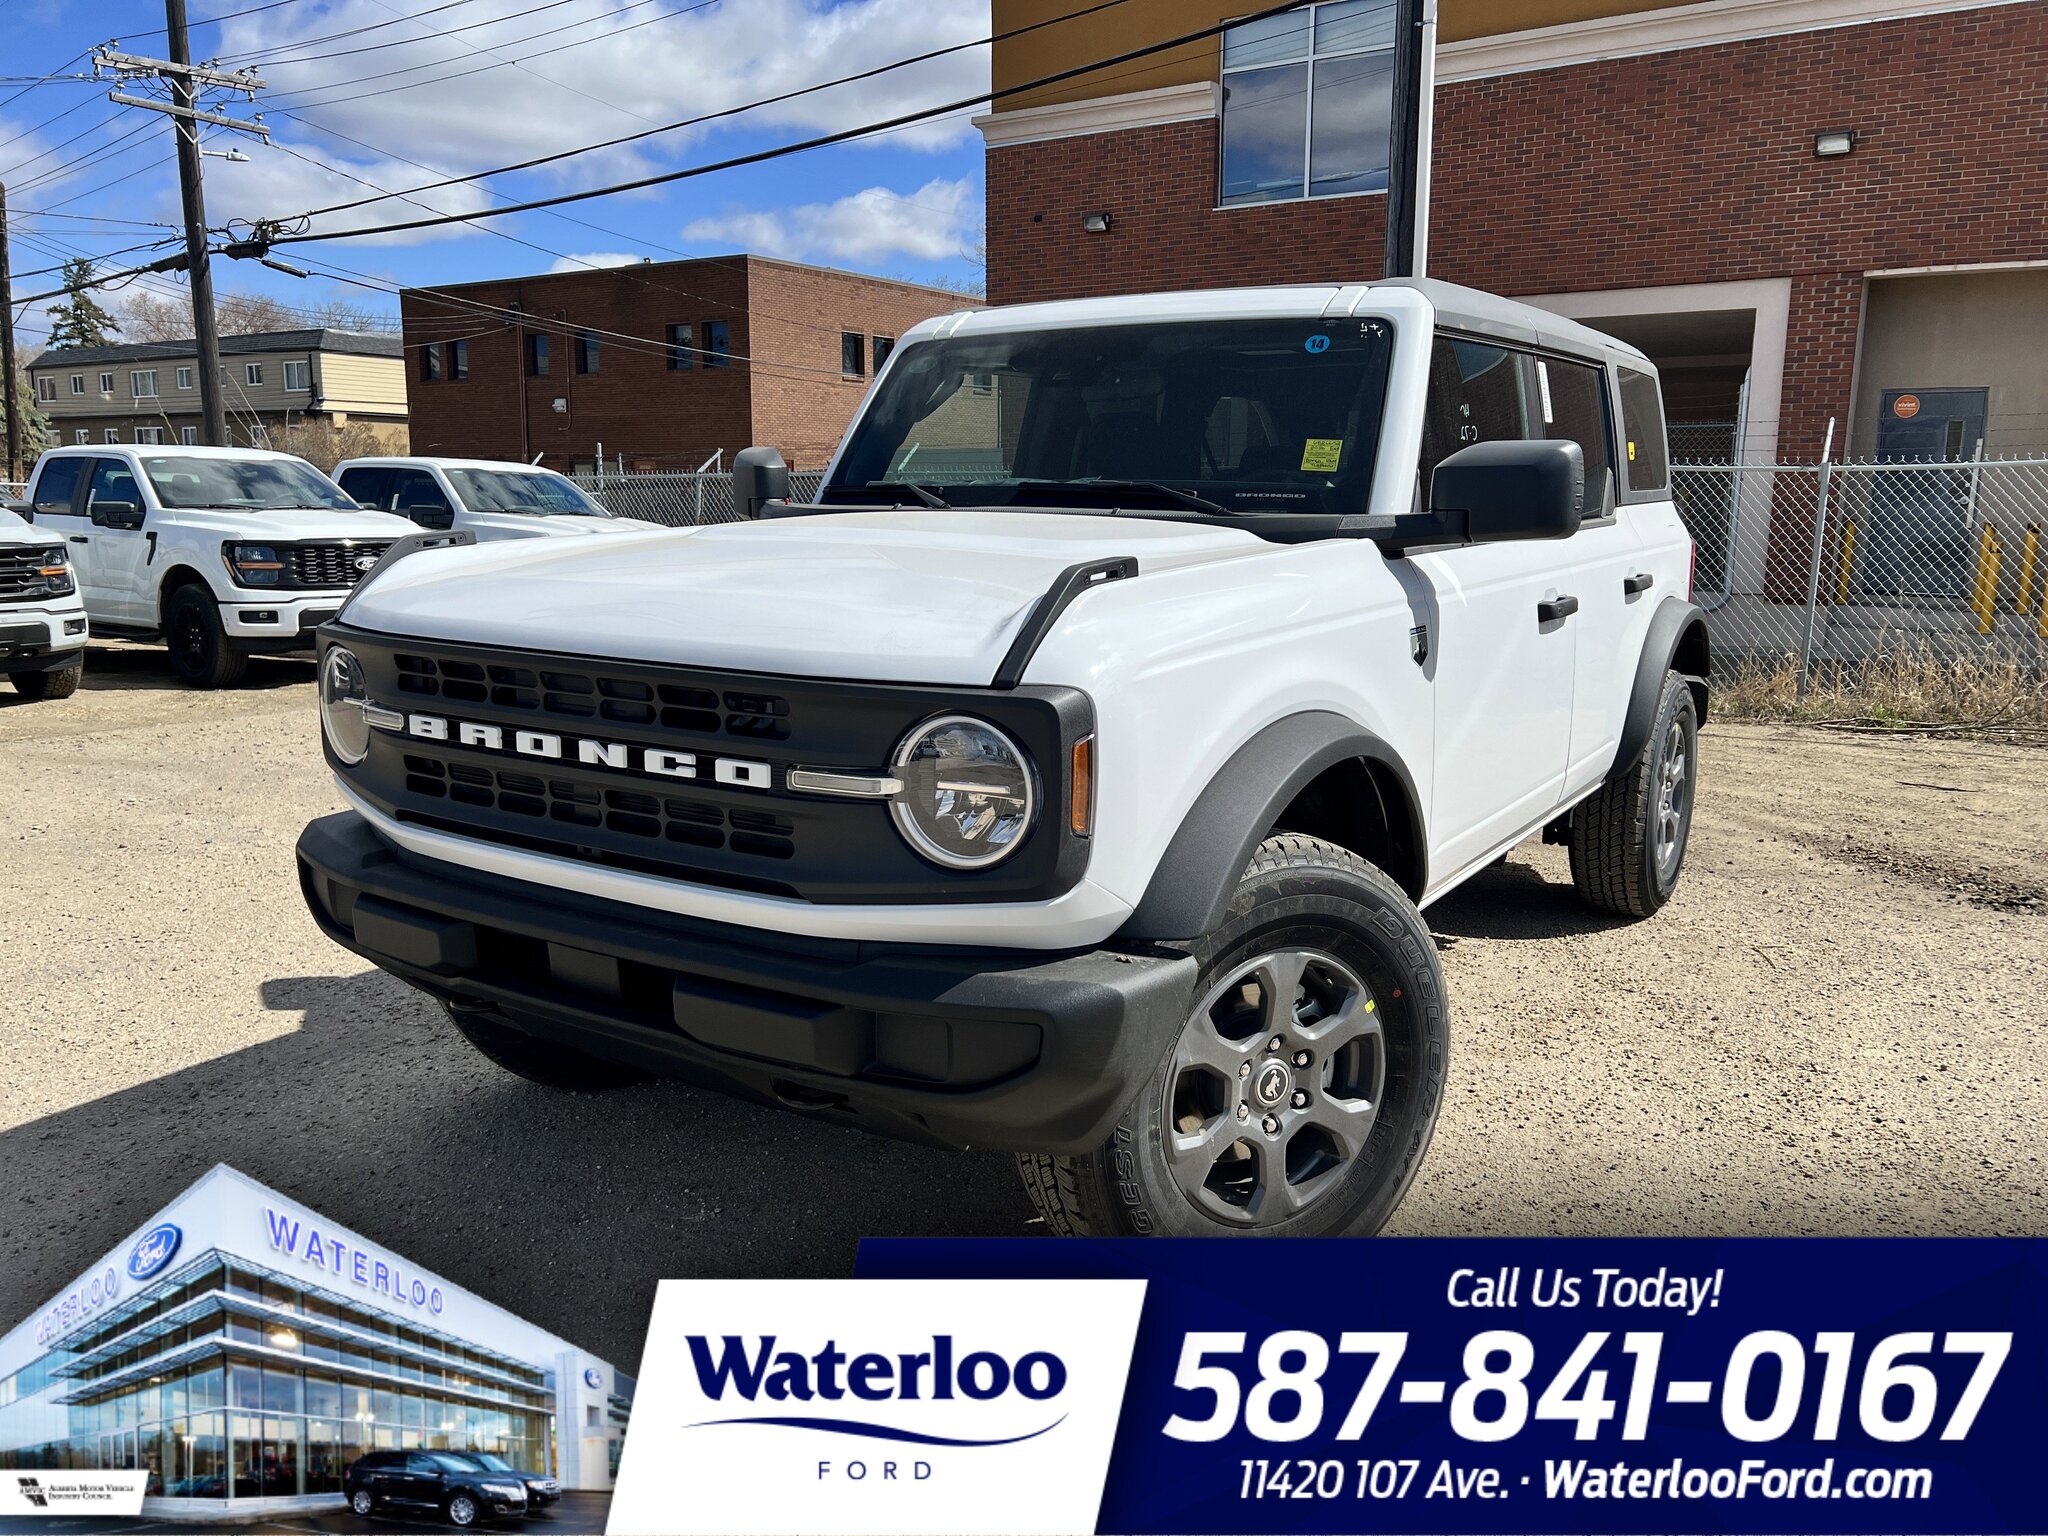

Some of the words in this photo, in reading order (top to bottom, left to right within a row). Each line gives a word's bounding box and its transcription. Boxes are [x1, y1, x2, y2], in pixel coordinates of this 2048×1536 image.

[1310, 338, 1325, 350] 14
[409, 713, 772, 789] BRONCO
[1371, 906, 1442, 1119] DUELER
